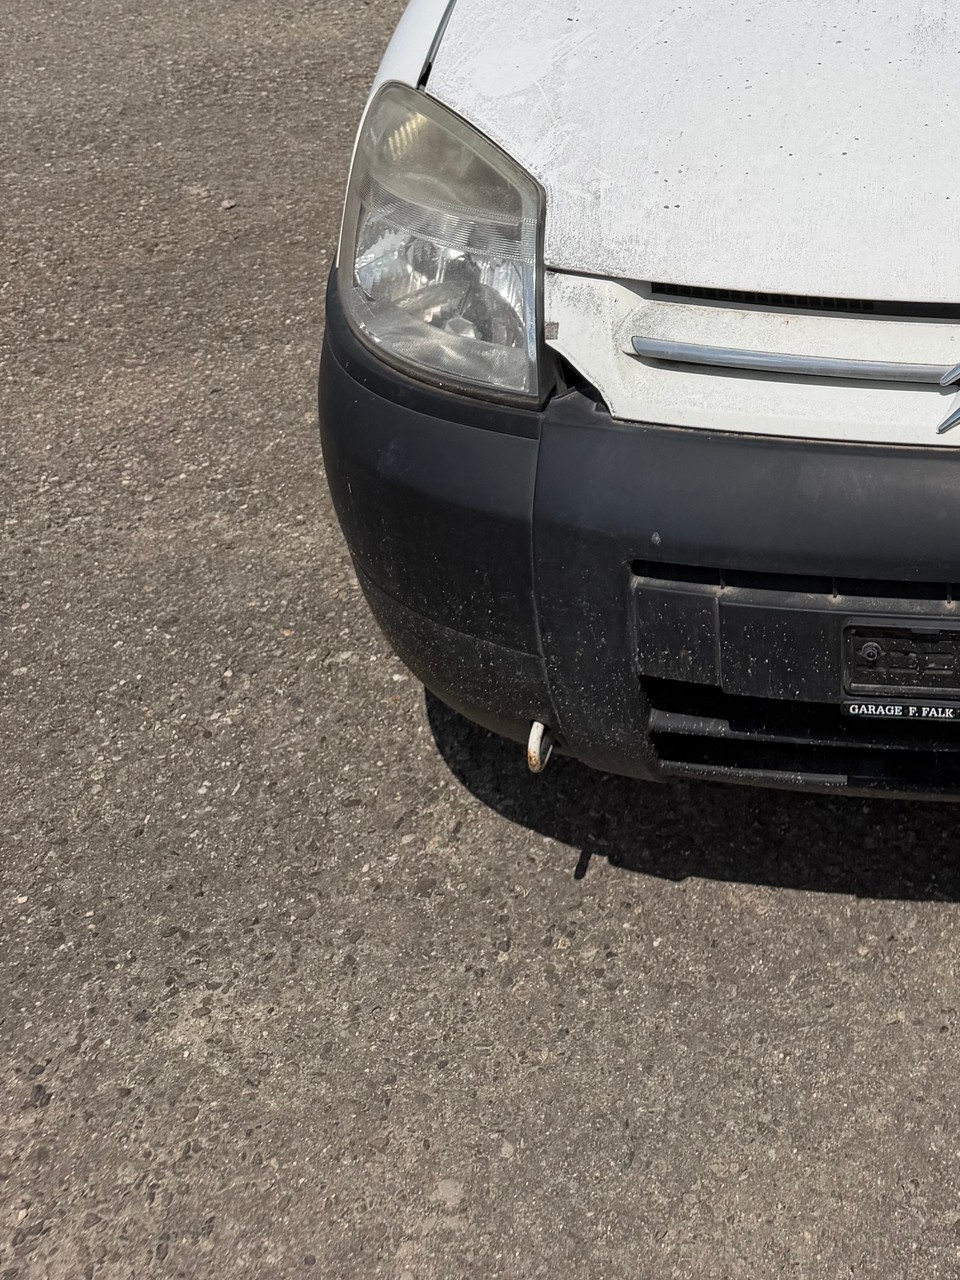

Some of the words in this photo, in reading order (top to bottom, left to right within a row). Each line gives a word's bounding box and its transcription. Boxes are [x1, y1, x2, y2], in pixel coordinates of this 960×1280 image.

[849, 704, 903, 716] GARAGE
[908, 706, 919, 717] F.
[921, 707, 954, 718] FALK
